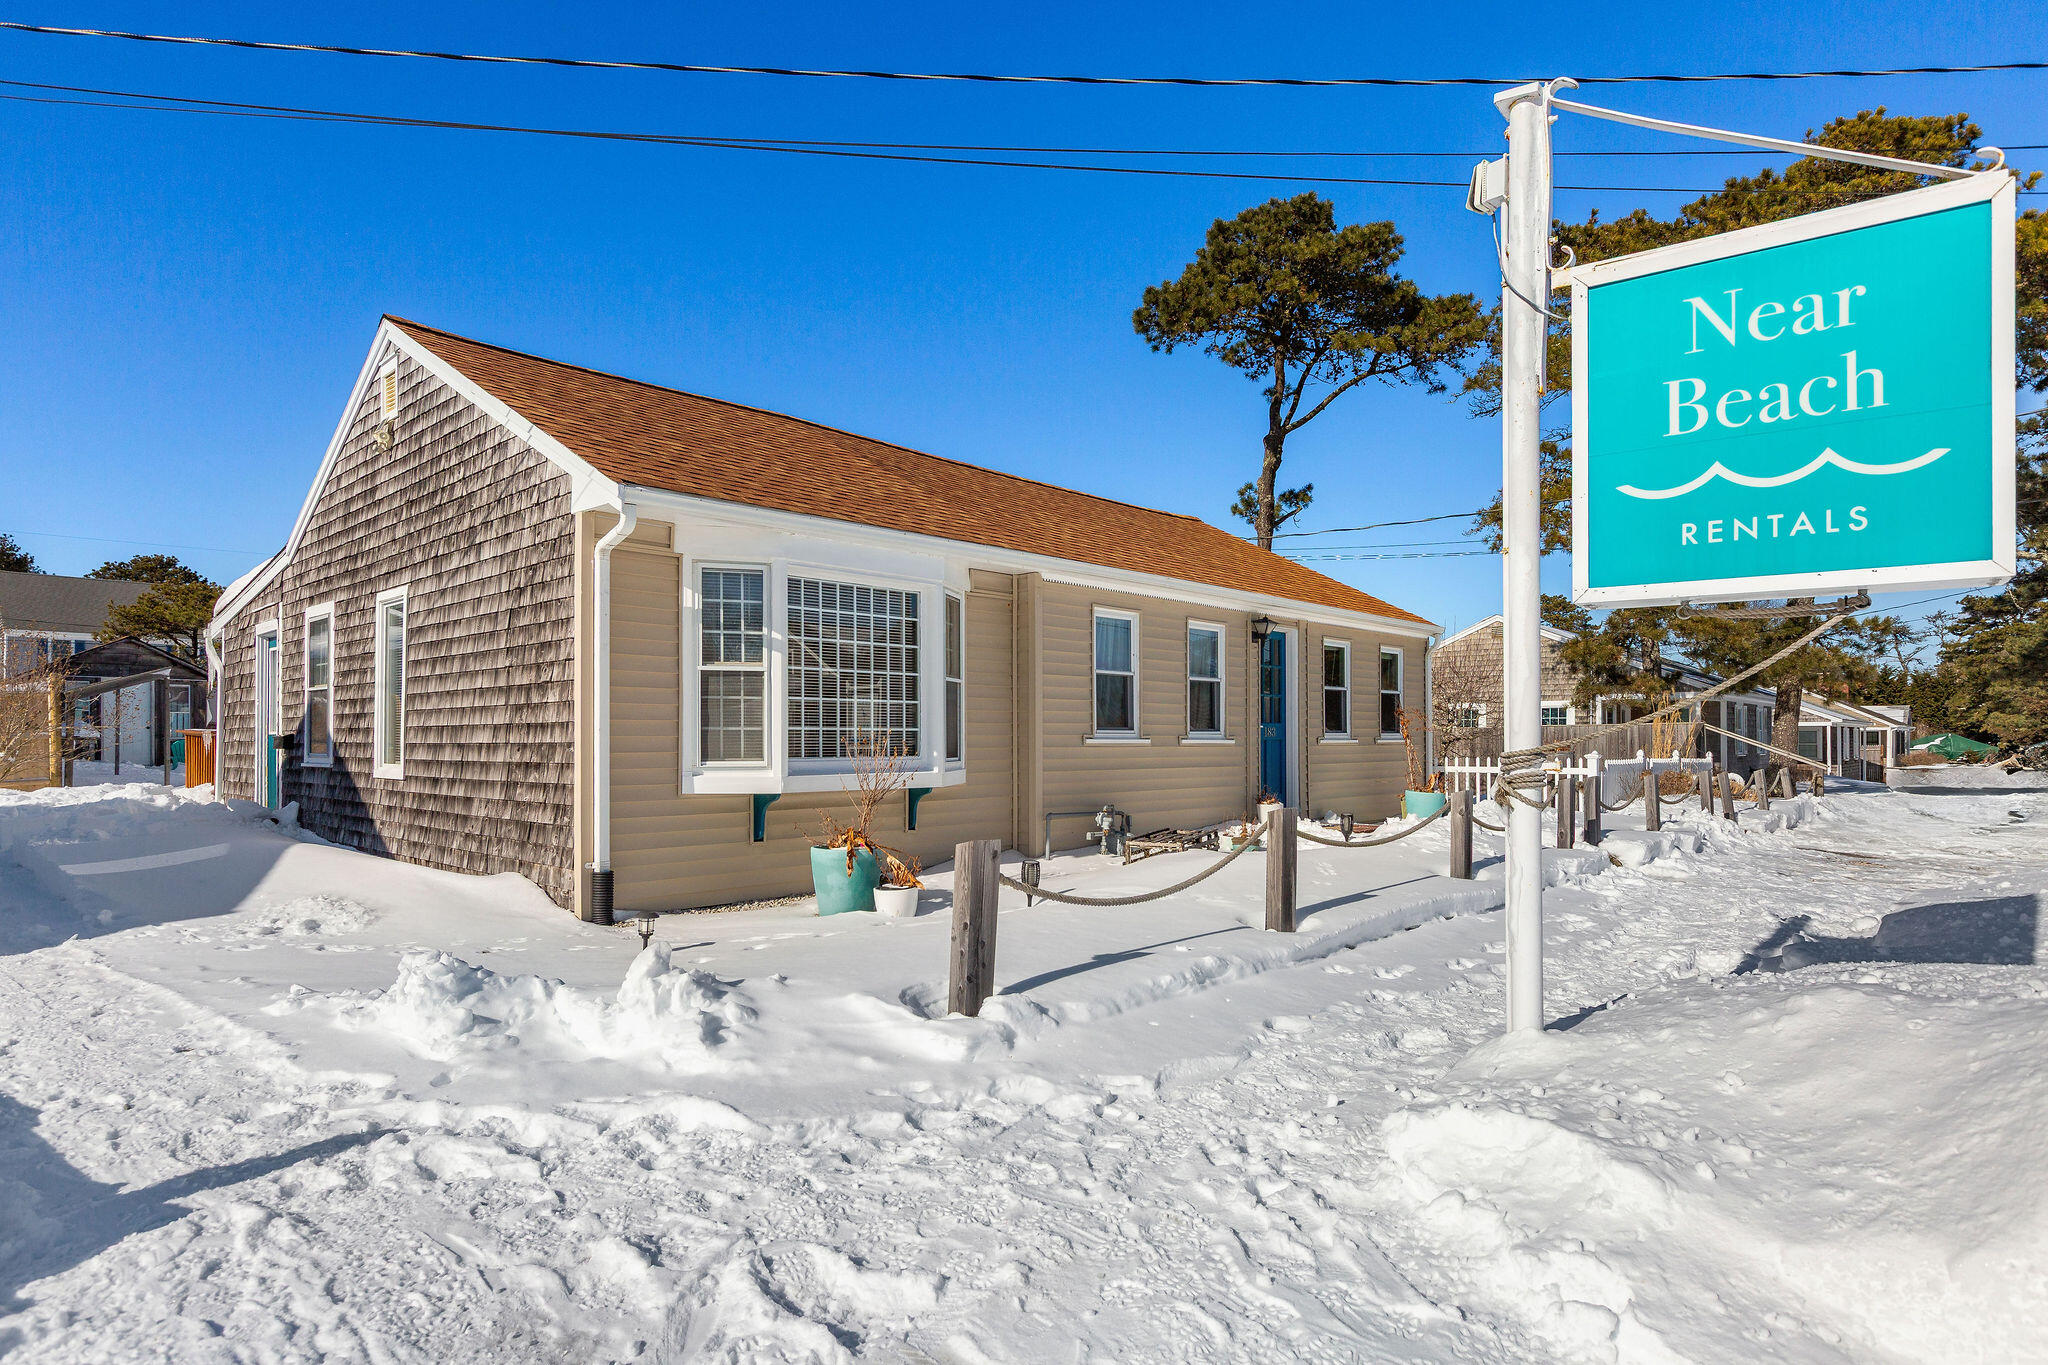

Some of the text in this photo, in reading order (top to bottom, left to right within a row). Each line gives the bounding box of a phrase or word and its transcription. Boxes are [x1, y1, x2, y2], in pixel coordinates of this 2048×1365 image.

[1683, 285, 1866, 355] Near
[1663, 350, 1889, 437] Beach
[1681, 505, 1869, 546] RENTALS
